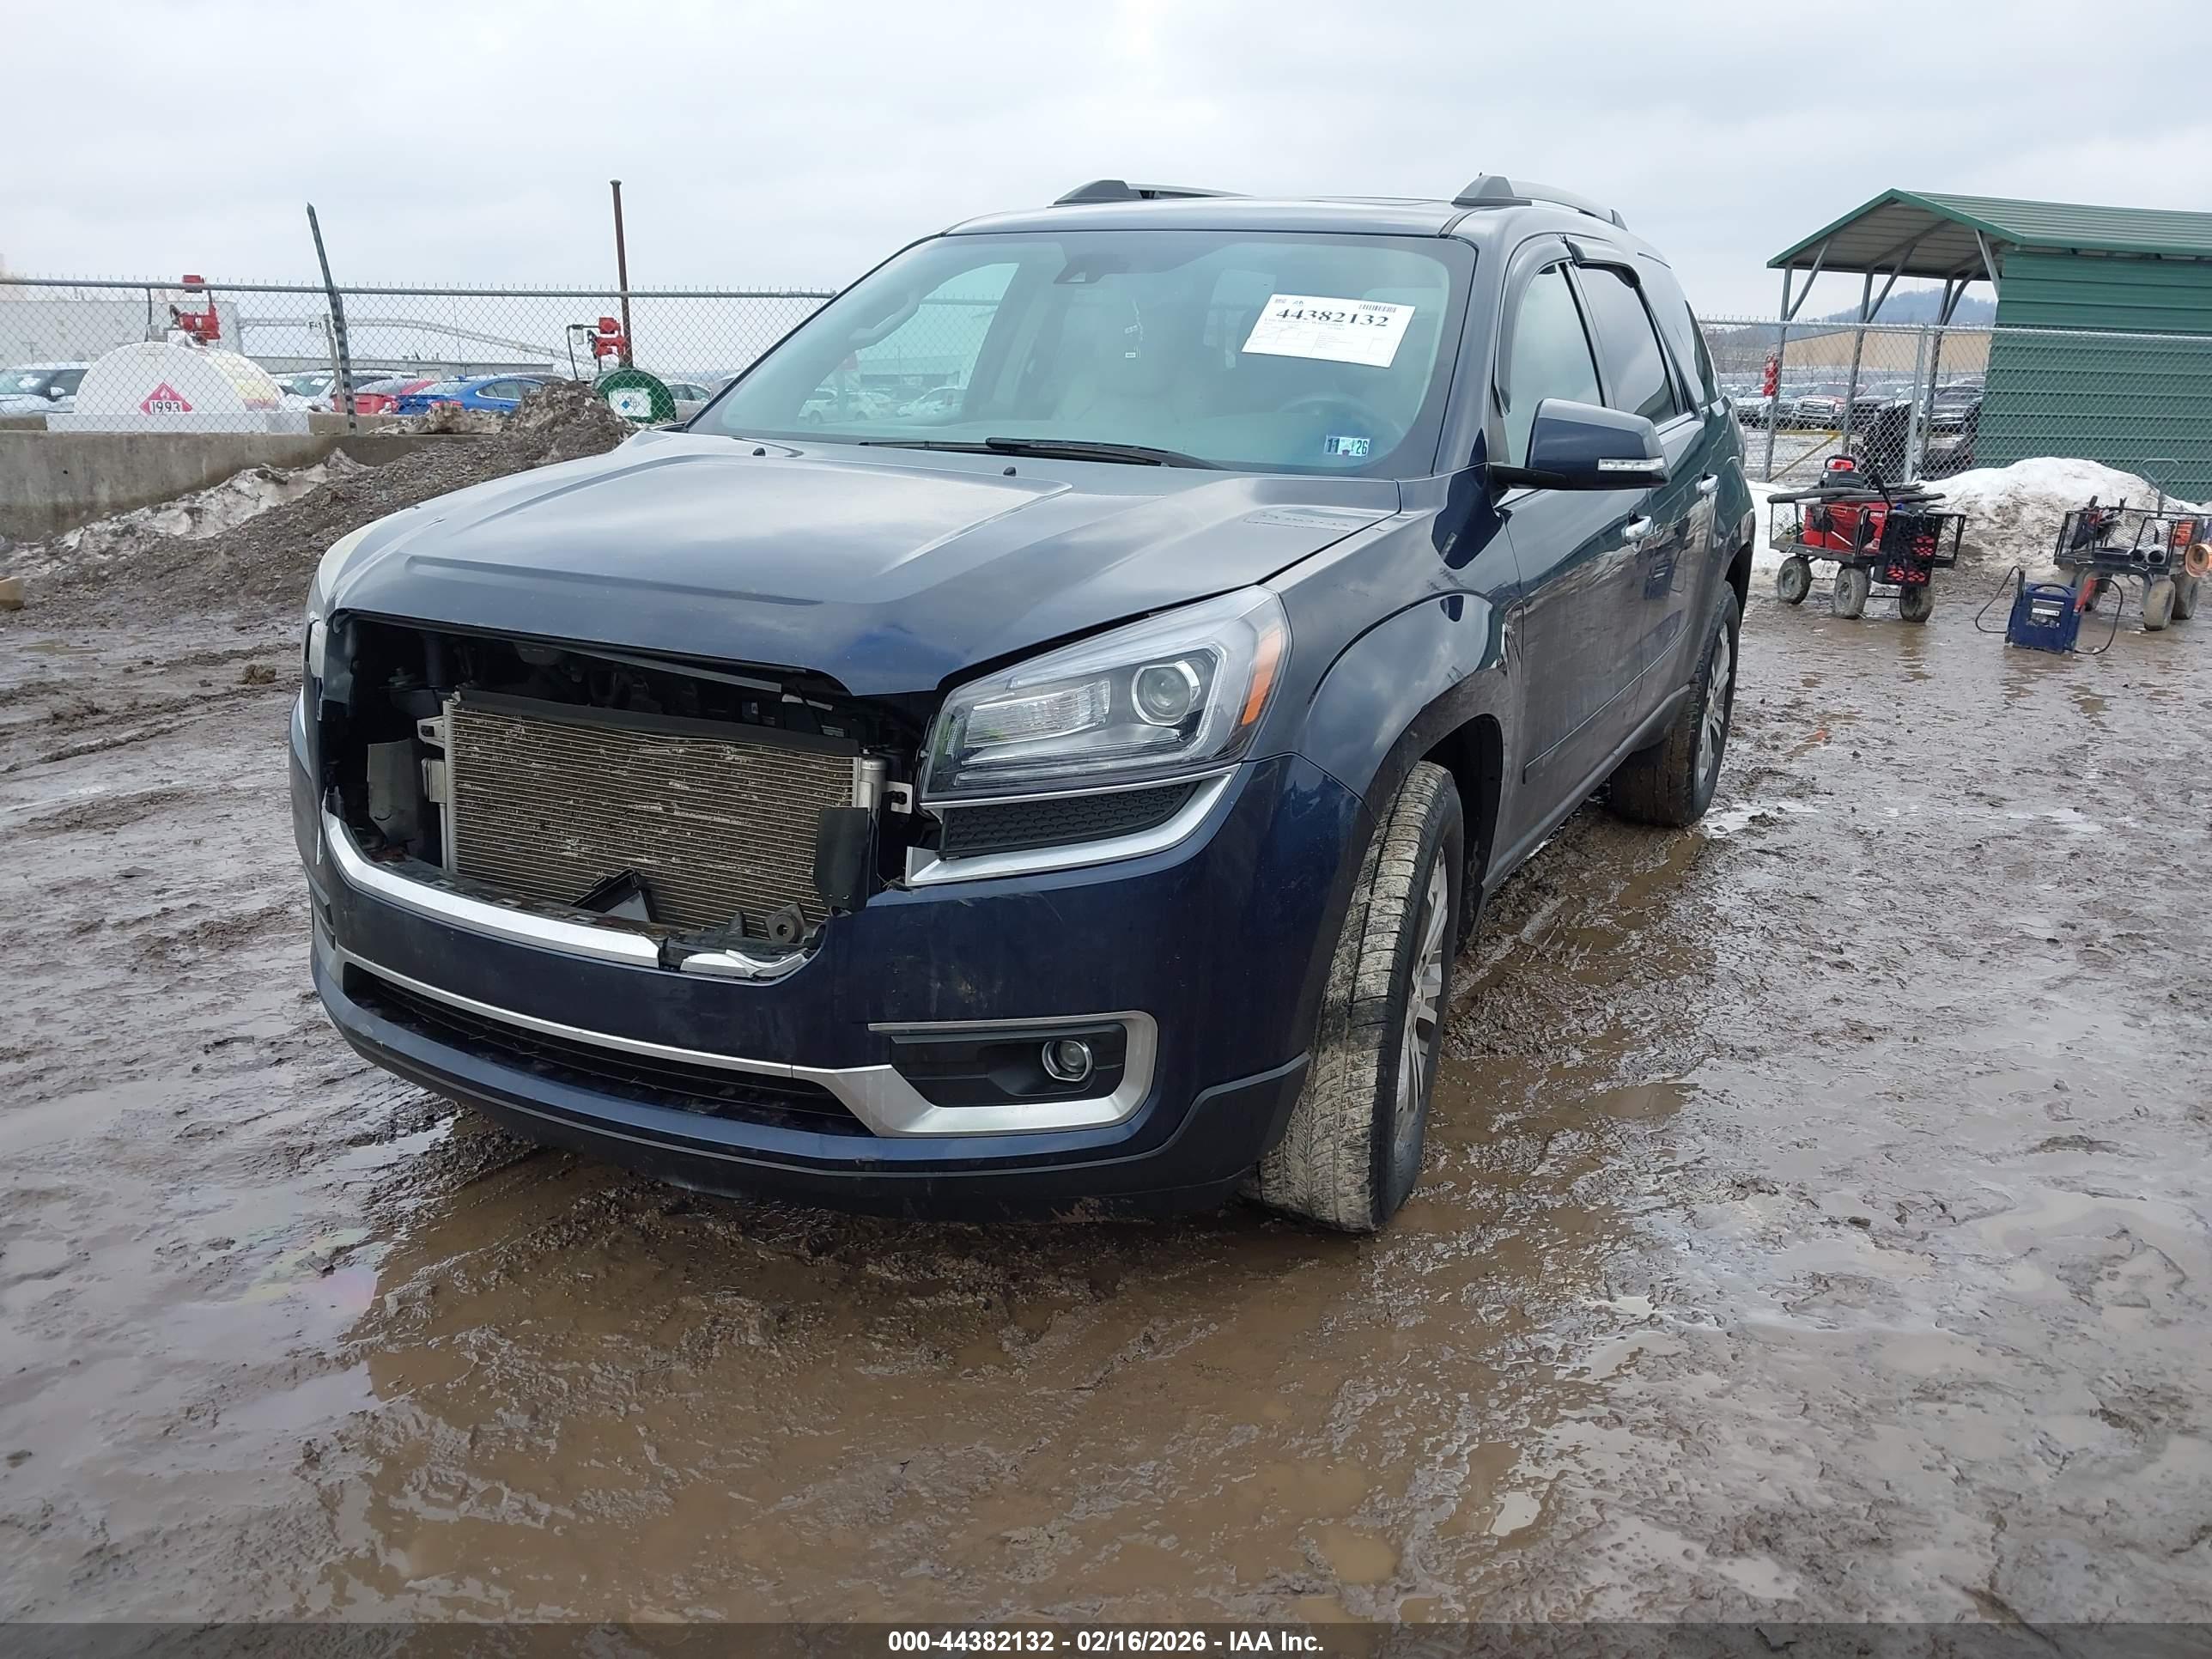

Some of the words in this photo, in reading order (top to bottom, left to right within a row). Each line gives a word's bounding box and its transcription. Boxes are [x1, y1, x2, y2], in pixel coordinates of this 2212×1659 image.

[1276, 308, 1389, 327] 44382132
[151, 401, 180, 413] 1993
[1328, 438, 1340, 453] 11
[1356, 440, 1368, 455] 26
